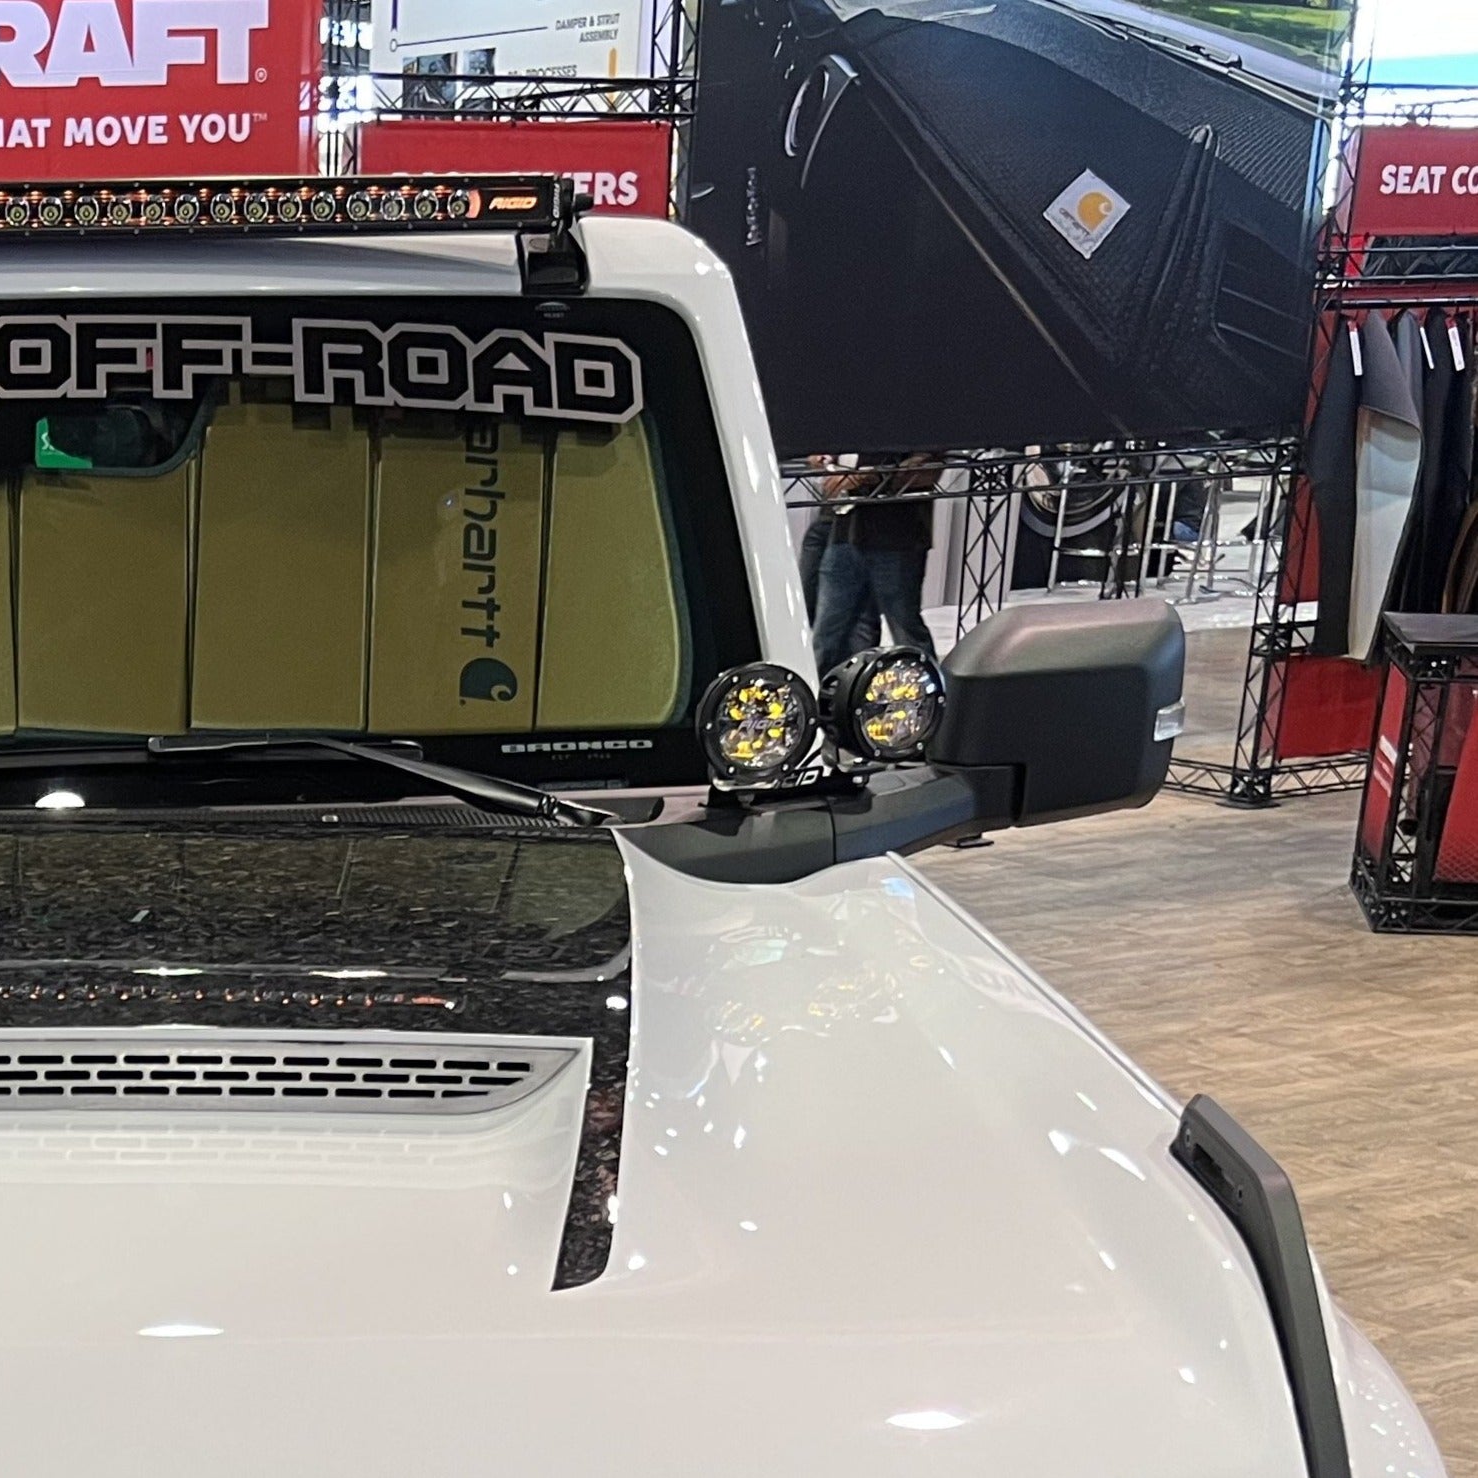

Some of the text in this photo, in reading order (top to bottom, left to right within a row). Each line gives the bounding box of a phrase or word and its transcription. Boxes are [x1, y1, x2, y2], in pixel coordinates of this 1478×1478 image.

[63, 114, 169, 147] MOVE
[1379, 164, 1448, 195] SEAT
[488, 195, 538, 210] RIGID
[460, 422, 506, 648] arhartt
[500, 739, 653, 754] BRONCO
